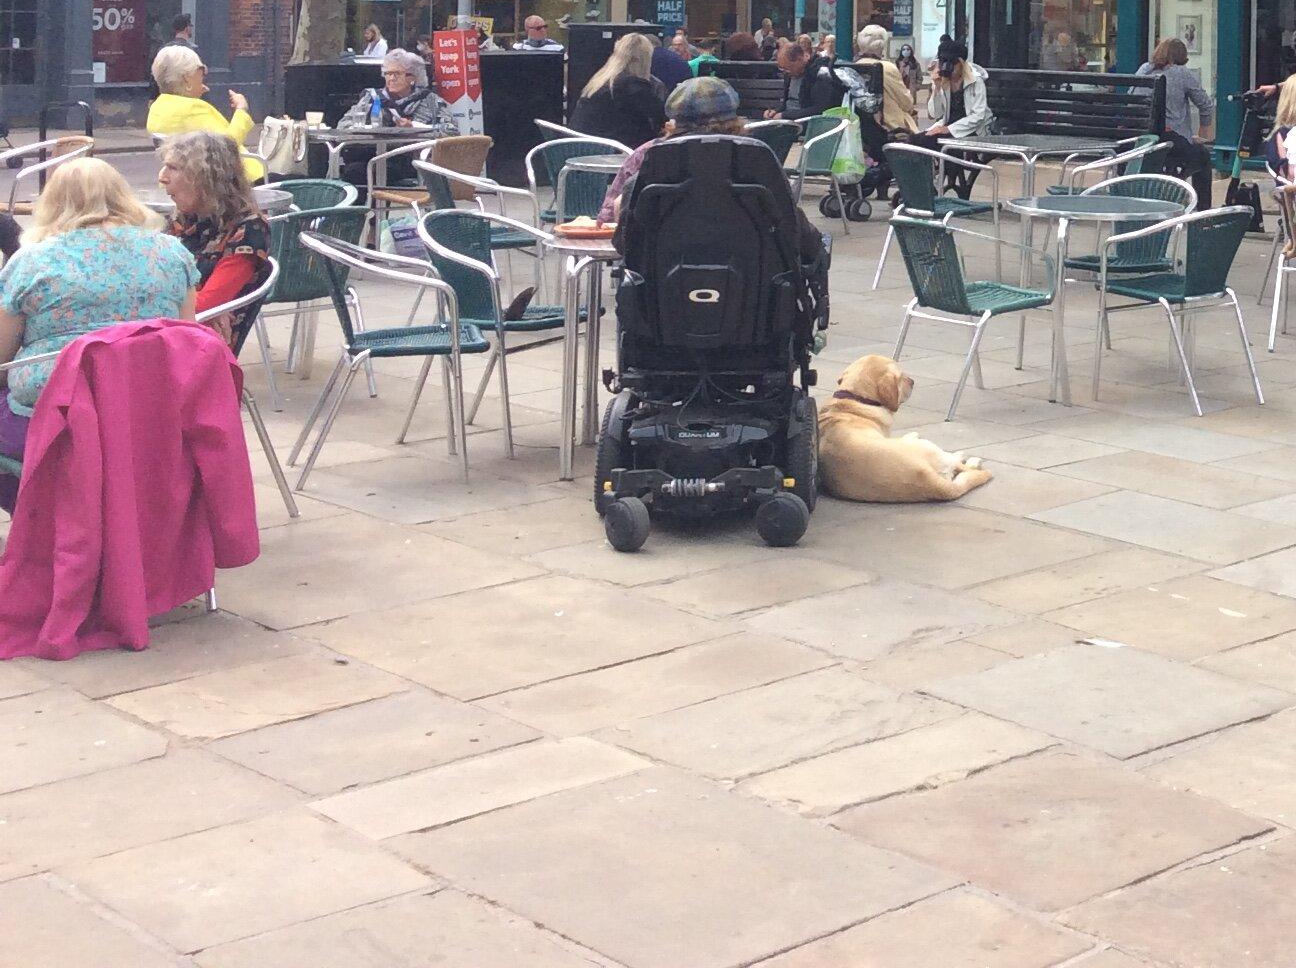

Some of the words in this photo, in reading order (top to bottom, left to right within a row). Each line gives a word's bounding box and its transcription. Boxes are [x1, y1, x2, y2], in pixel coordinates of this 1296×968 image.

[657, 0, 683, 12] HALF
[893, 5, 912, 15] HALF
[92, 7, 136, 31] 50%
[657, 12, 683, 23] PRICE
[893, 15, 912, 25] PRICE
[438, 38, 458, 48] Let's
[439, 52, 459, 63] keep
[440, 64, 460, 75] York
[441, 79, 461, 90] open
